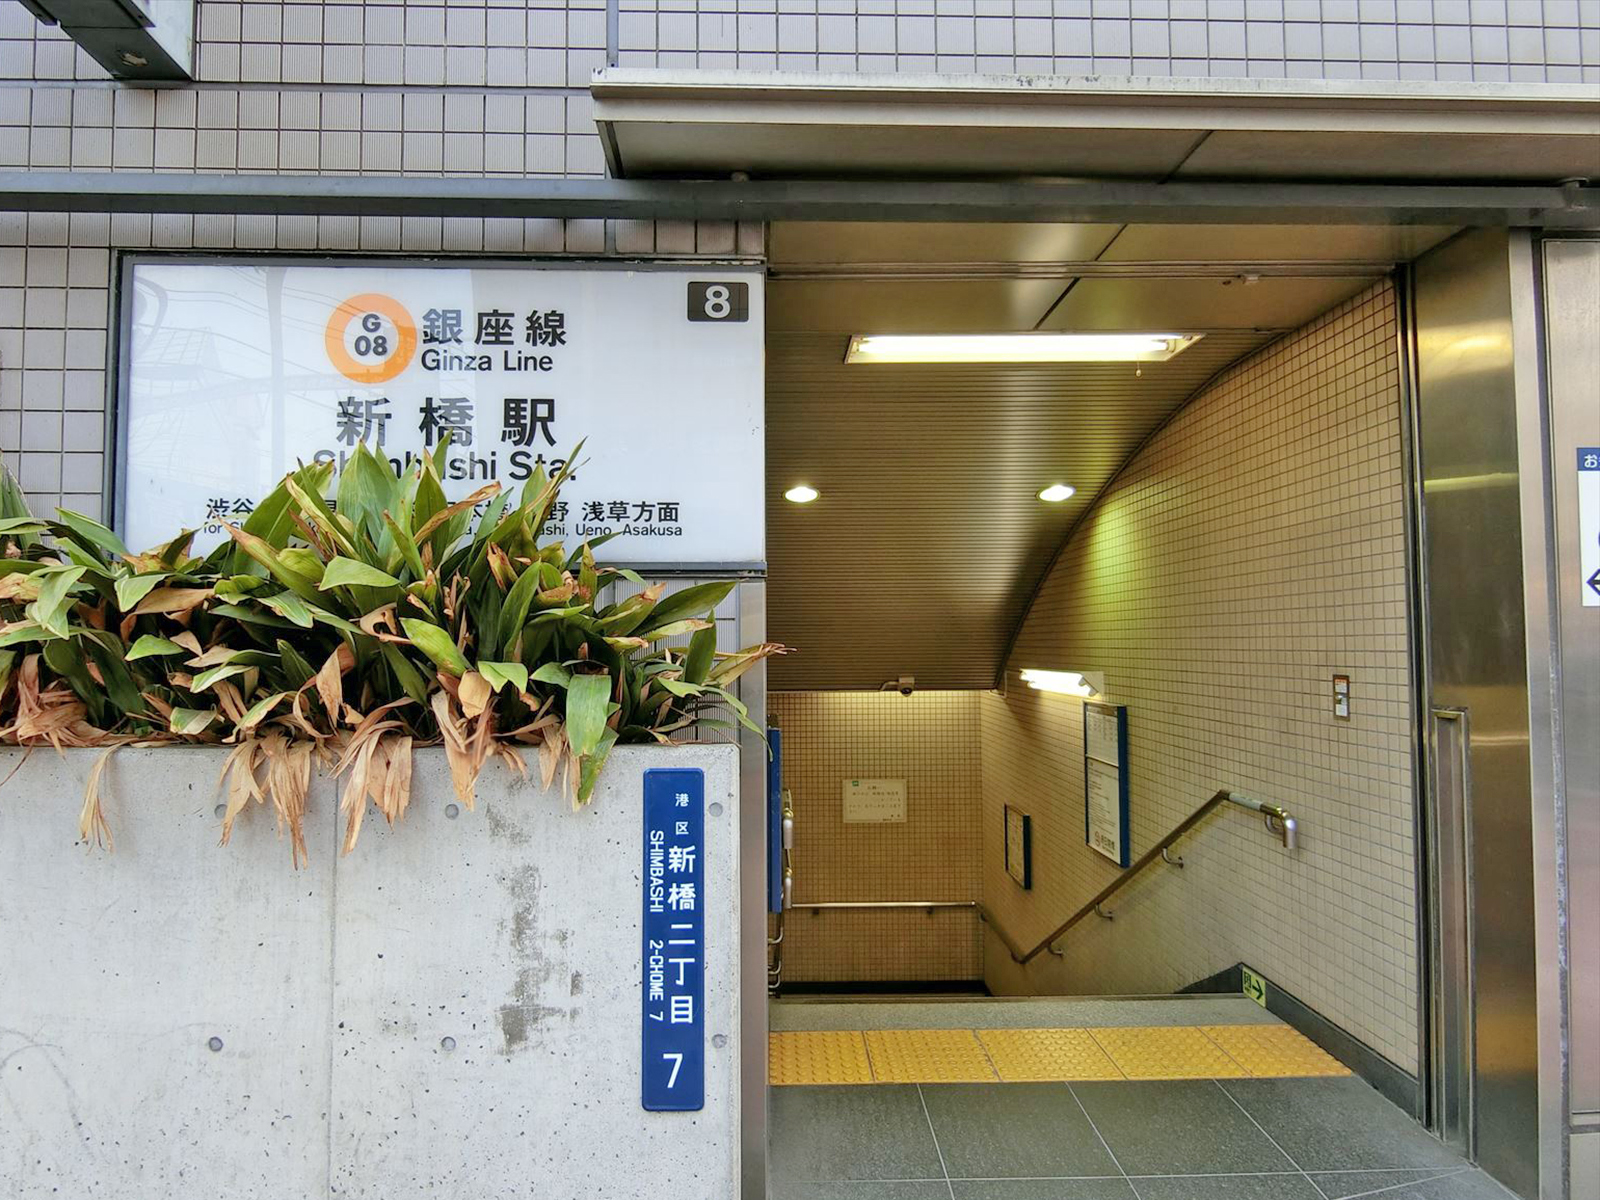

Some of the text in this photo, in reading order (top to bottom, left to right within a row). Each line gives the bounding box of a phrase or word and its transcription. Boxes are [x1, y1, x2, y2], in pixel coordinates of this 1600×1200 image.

[704, 285, 731, 318] 8
[362, 313, 382, 333] G
[422, 308, 567, 347] 銀座線
[354, 335, 388, 356] 08
[421, 348, 553, 371] Ginza Line
[336, 396, 557, 447] 新橋駅
[1584, 453, 1600, 469] お
[581, 501, 681, 523] 浅草方面
[622, 523, 683, 536] Asakusa
[675, 793, 689, 835] 港区
[649, 829, 665, 1021] SHIMBASHI 2-CHOME 7
[662, 1053, 683, 1088] 7
